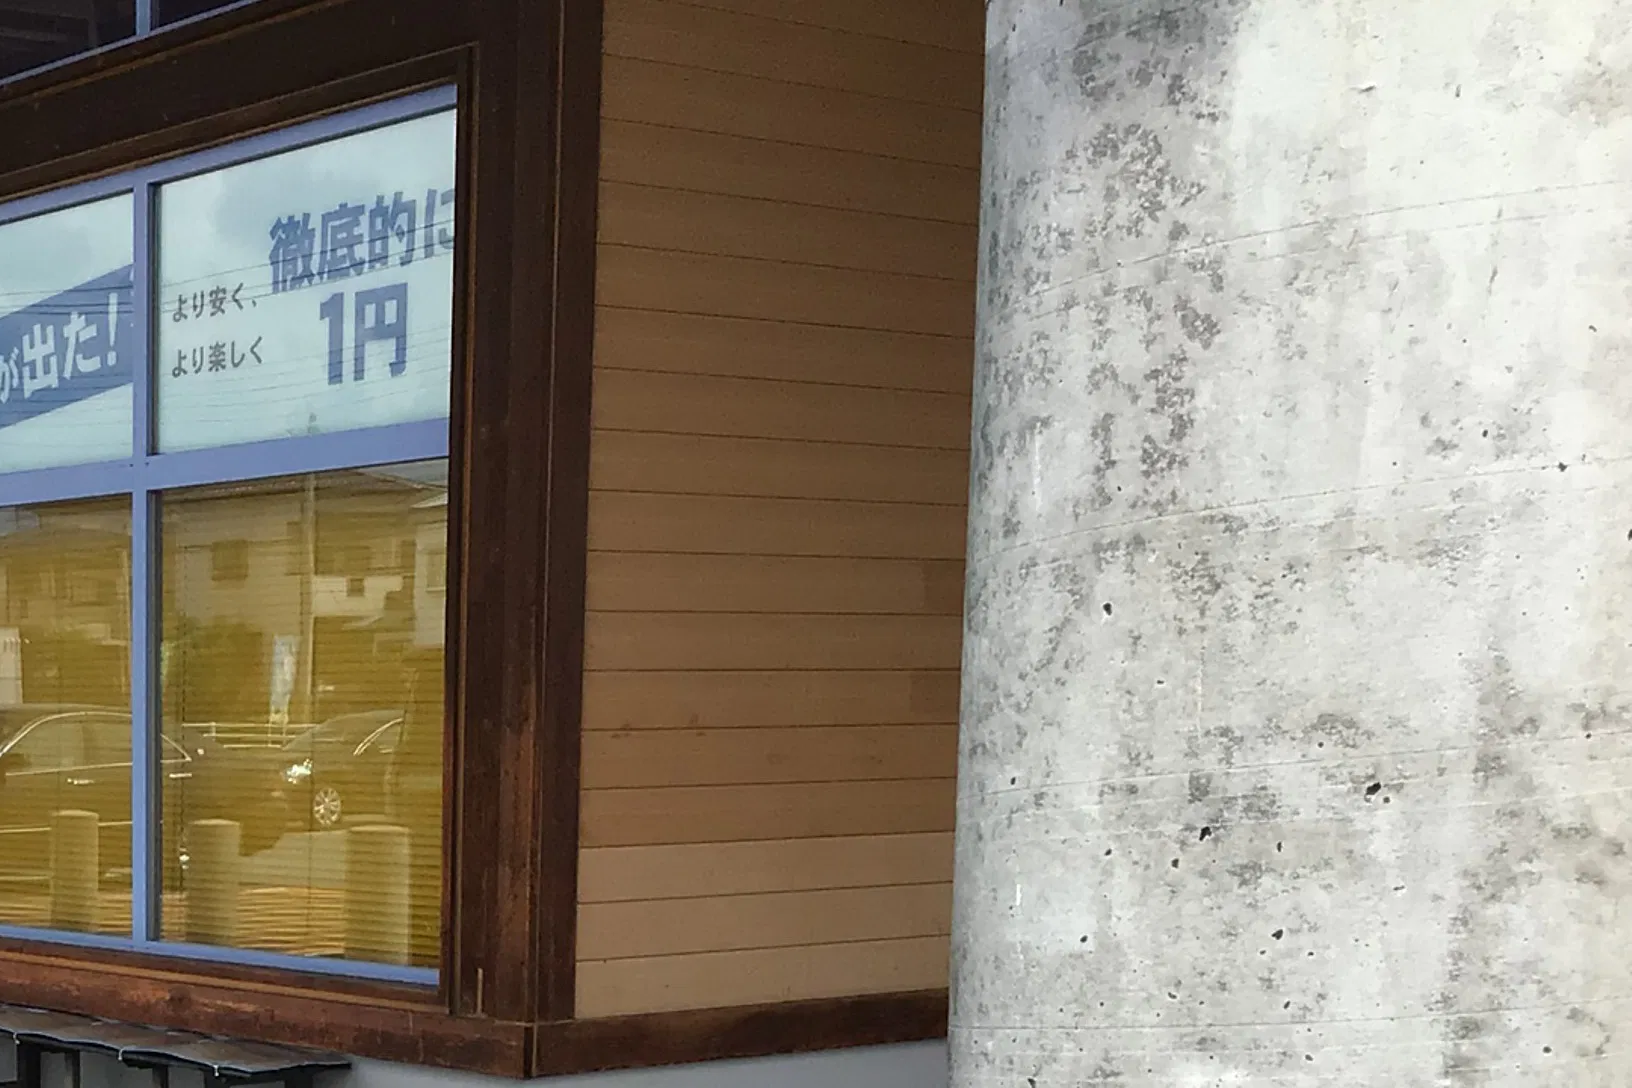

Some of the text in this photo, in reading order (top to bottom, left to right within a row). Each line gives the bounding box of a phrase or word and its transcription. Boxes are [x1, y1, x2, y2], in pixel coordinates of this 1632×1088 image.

[269, 188, 455, 294] 徹底的に
[172, 282, 257, 323] より安く、
[319, 282, 409, 386] 1円
[171, 336, 263, 378] より楽しく
